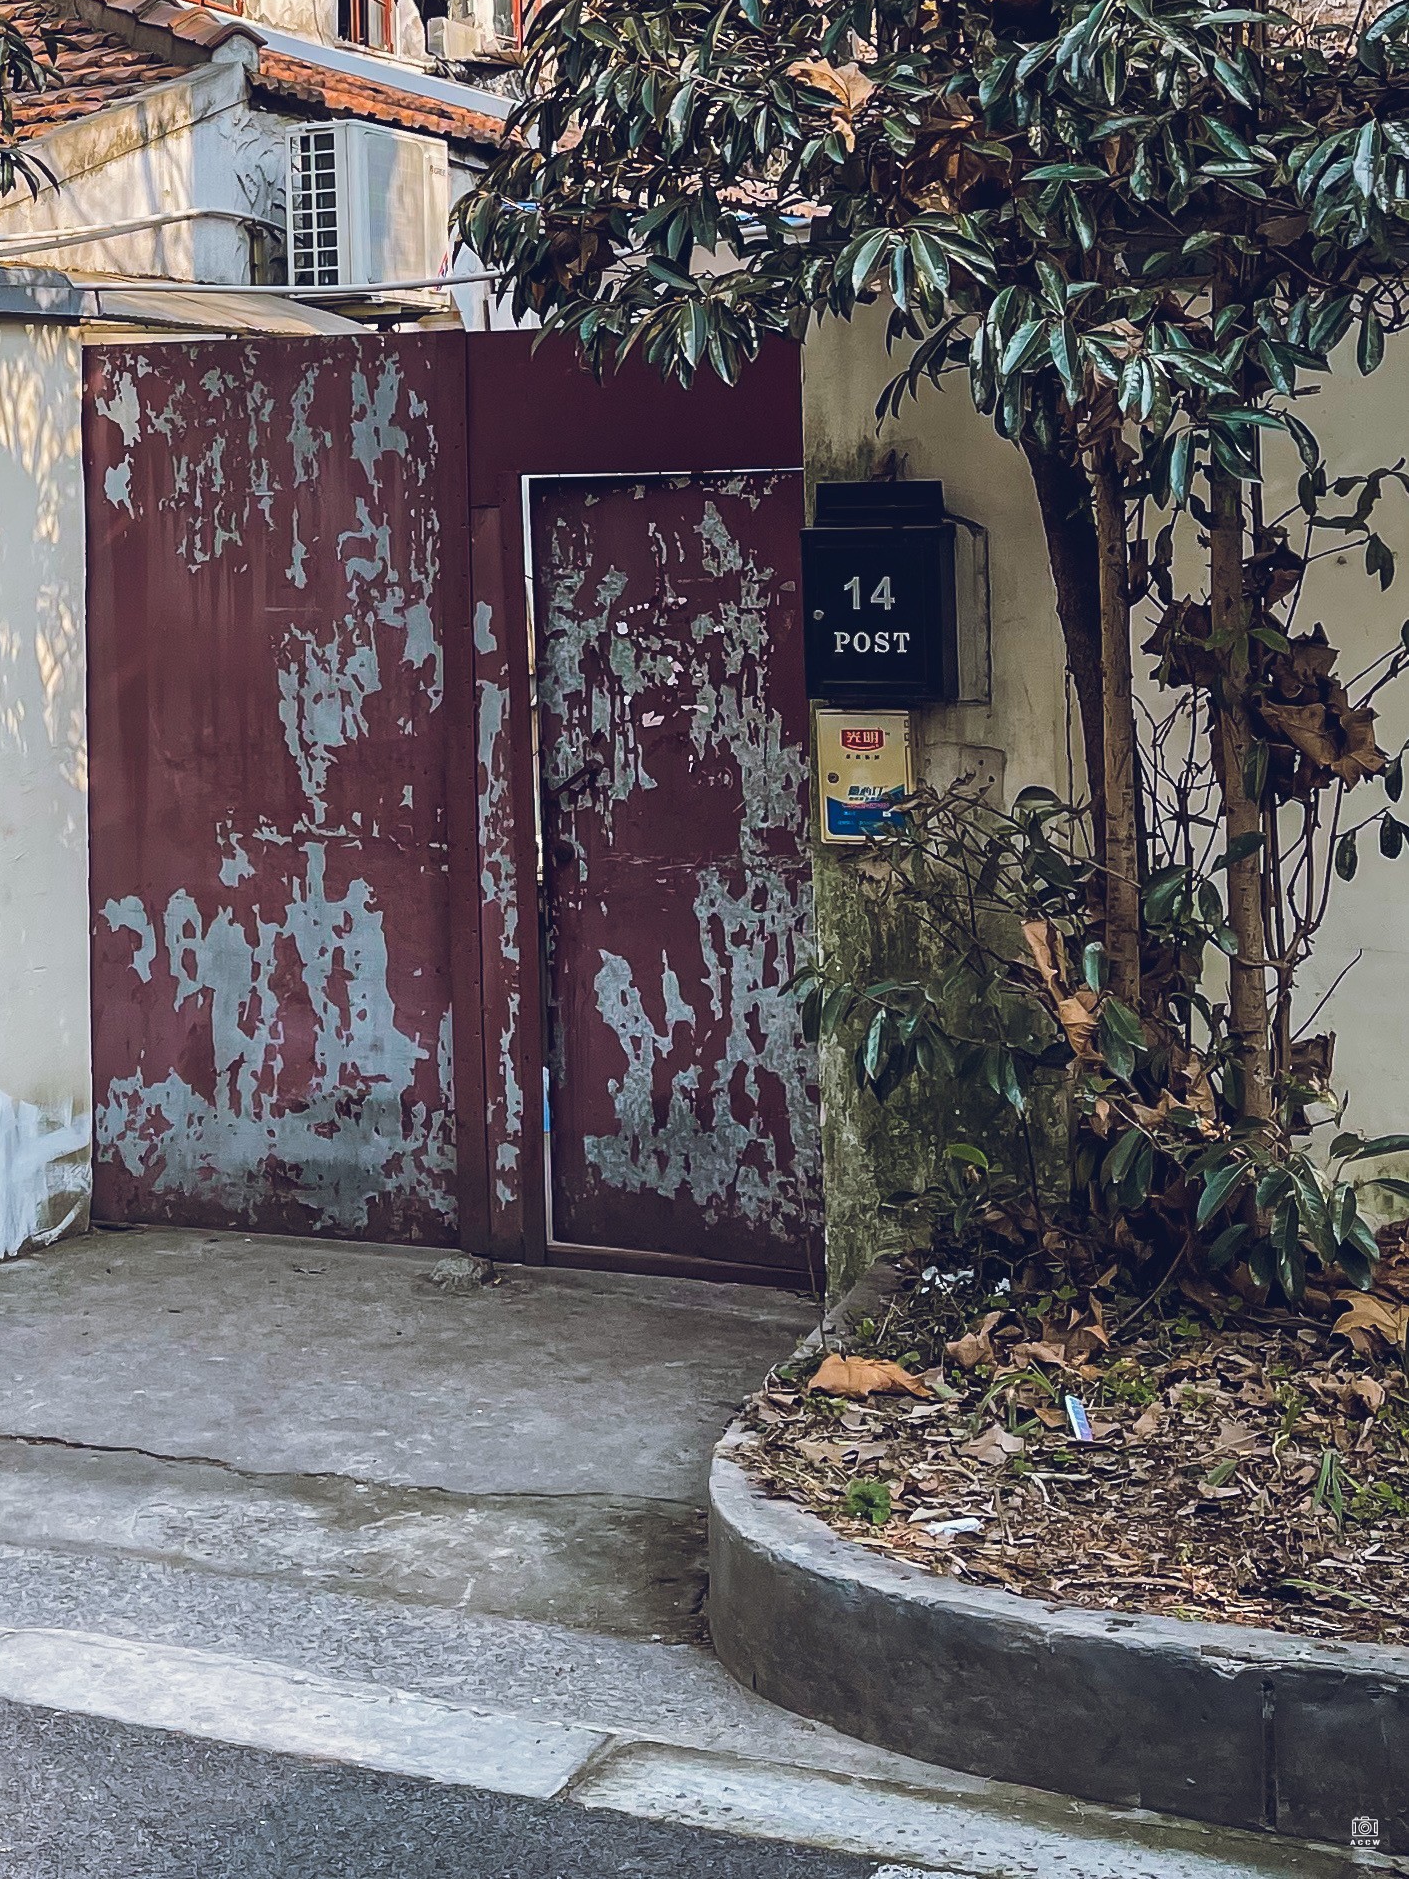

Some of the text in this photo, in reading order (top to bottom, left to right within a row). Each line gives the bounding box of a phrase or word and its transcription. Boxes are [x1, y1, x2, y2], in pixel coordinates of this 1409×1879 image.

[843, 576, 896, 611] 14
[833, 631, 911, 653] POST
[846, 731, 879, 744] 光明
